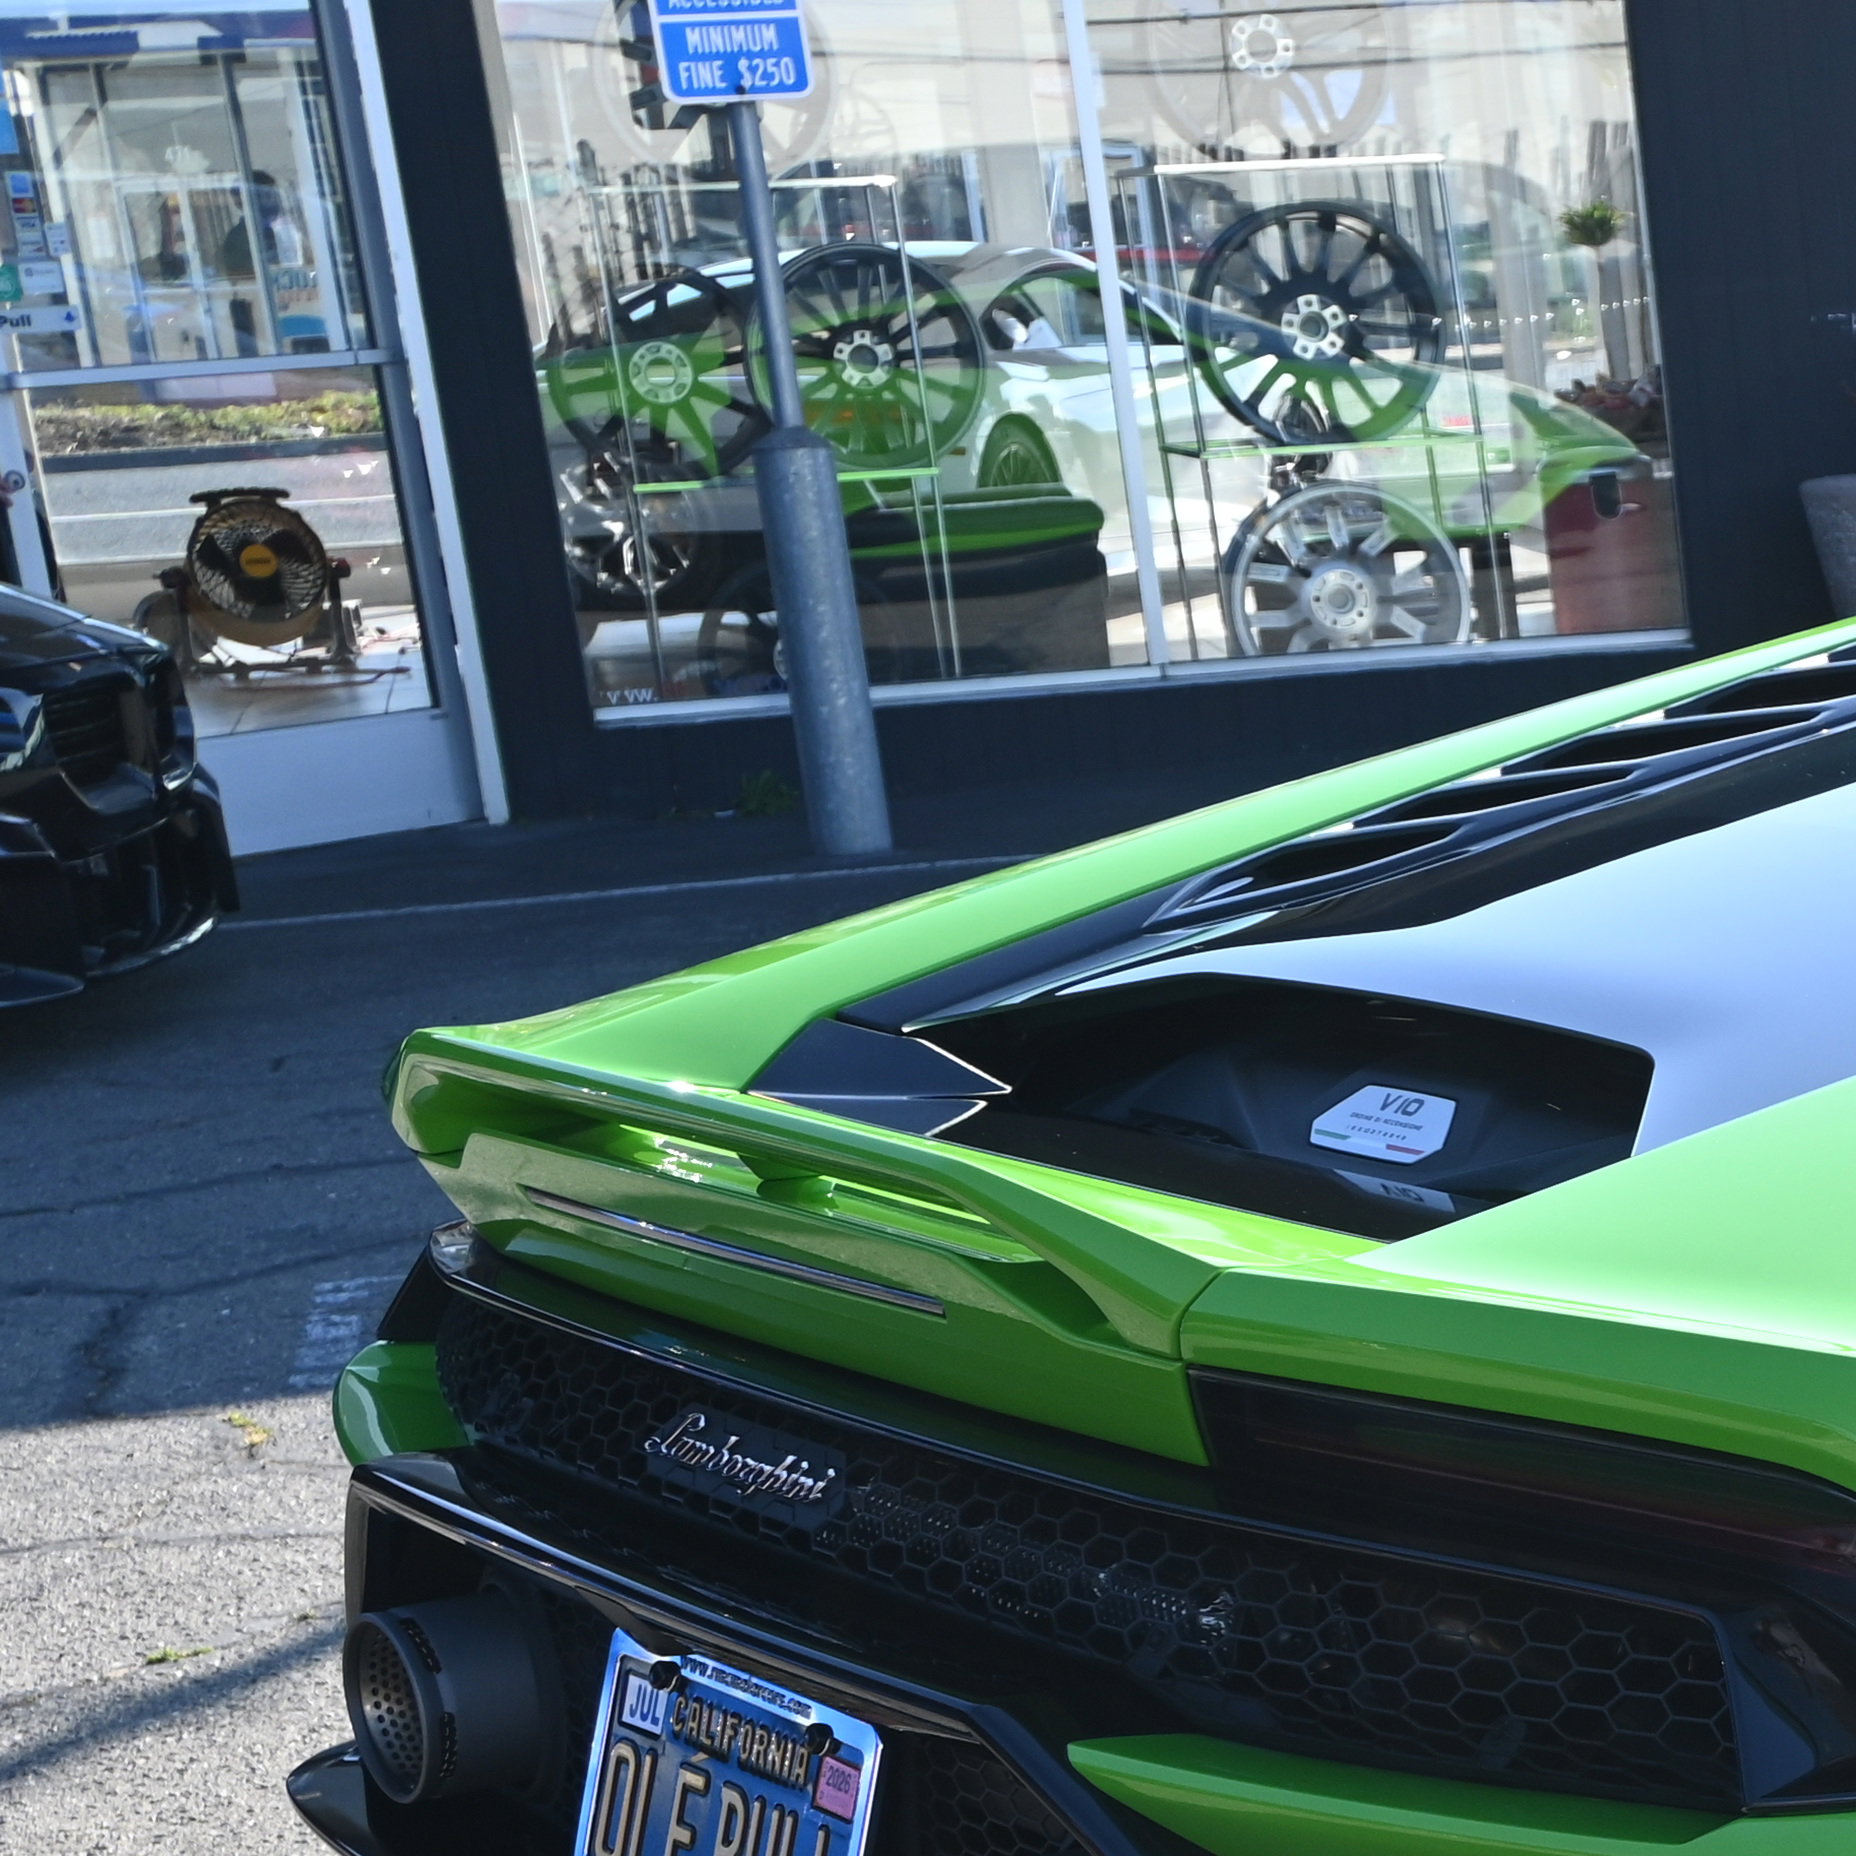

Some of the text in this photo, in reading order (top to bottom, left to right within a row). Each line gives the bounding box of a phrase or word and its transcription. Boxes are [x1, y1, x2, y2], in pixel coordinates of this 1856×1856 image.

[685, 23, 779, 54] MINIMUM
[678, 56, 797, 90] FINE $250
[644, 1412, 836, 1502] Lamborghini
[627, 1684, 660, 1727] JUL
[669, 1692, 810, 1781] CALIFORNIA
[826, 1765, 852, 1794] 2026
